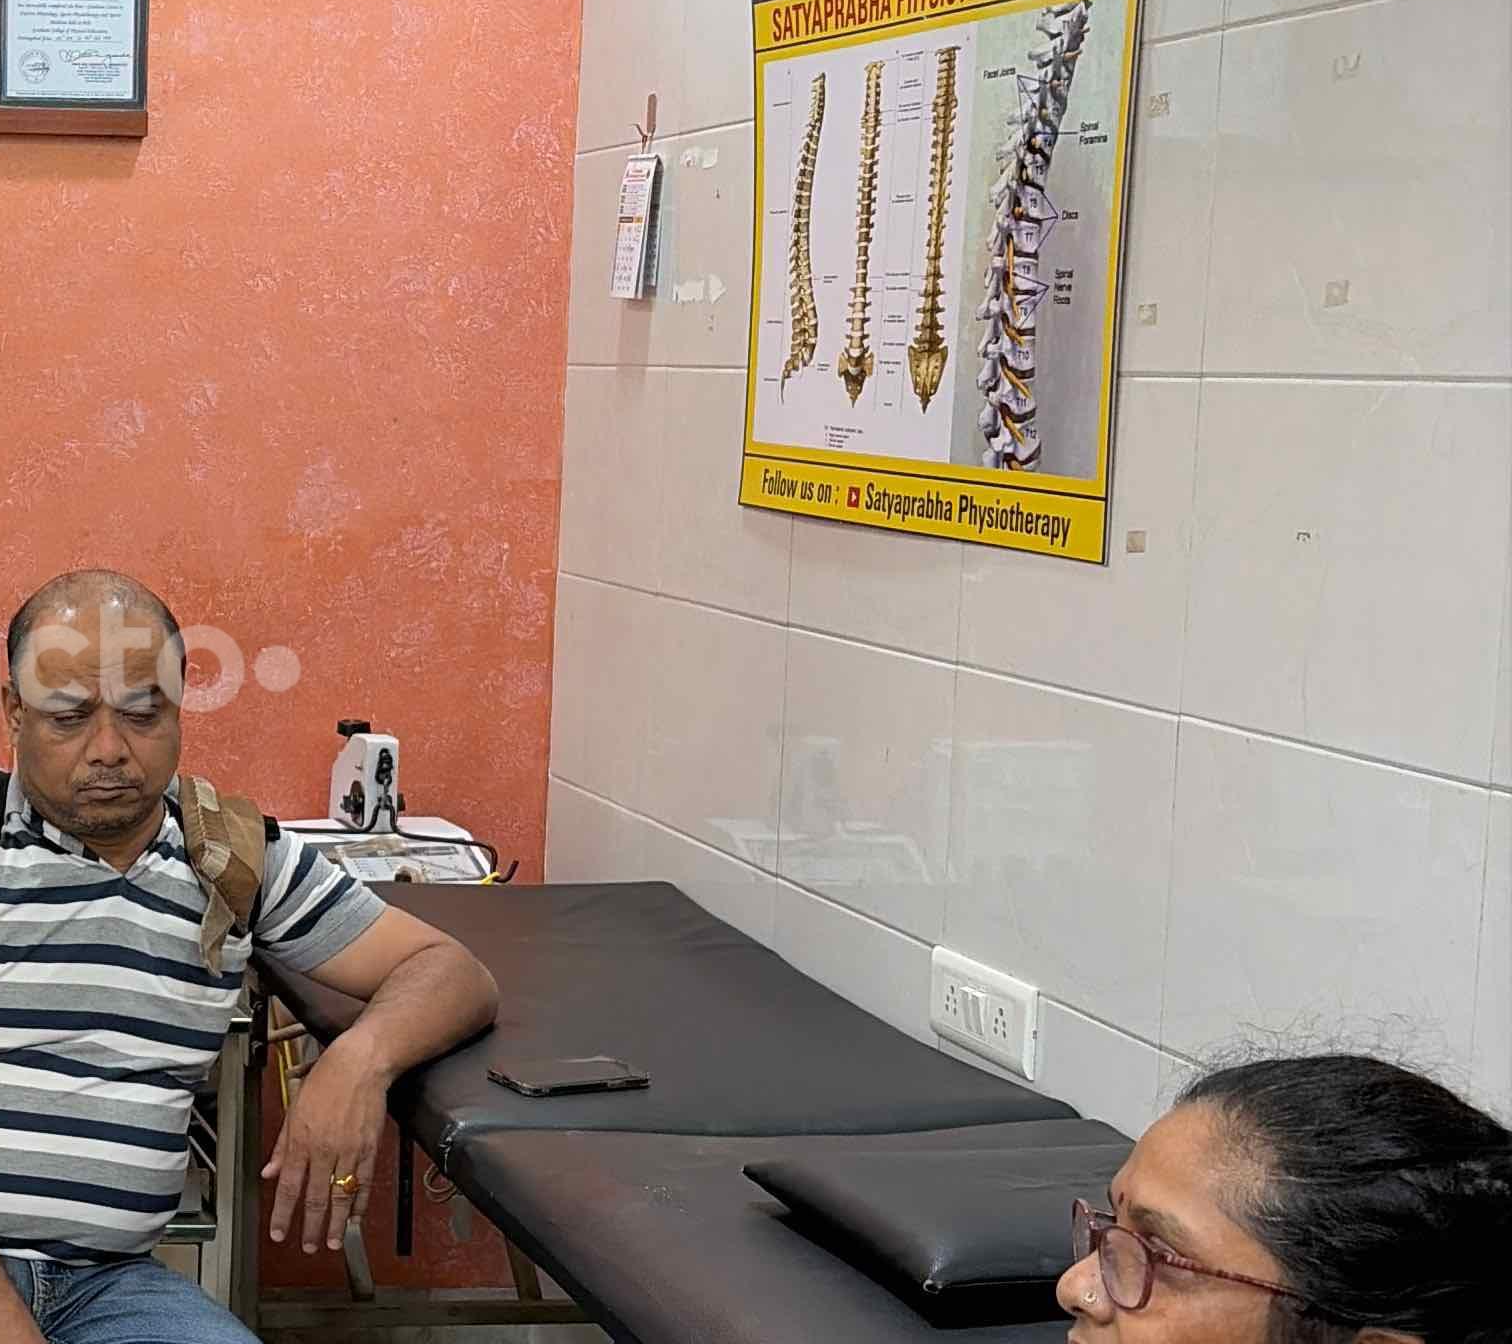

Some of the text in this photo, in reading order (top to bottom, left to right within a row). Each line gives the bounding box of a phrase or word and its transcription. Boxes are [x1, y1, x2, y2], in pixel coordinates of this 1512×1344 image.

[761, 468, 798, 498] Follow
[800, 483, 814, 501] us
[816, 486, 832, 503] on
[864, 482, 1071, 548] Satyaprabha Physiotherapy
